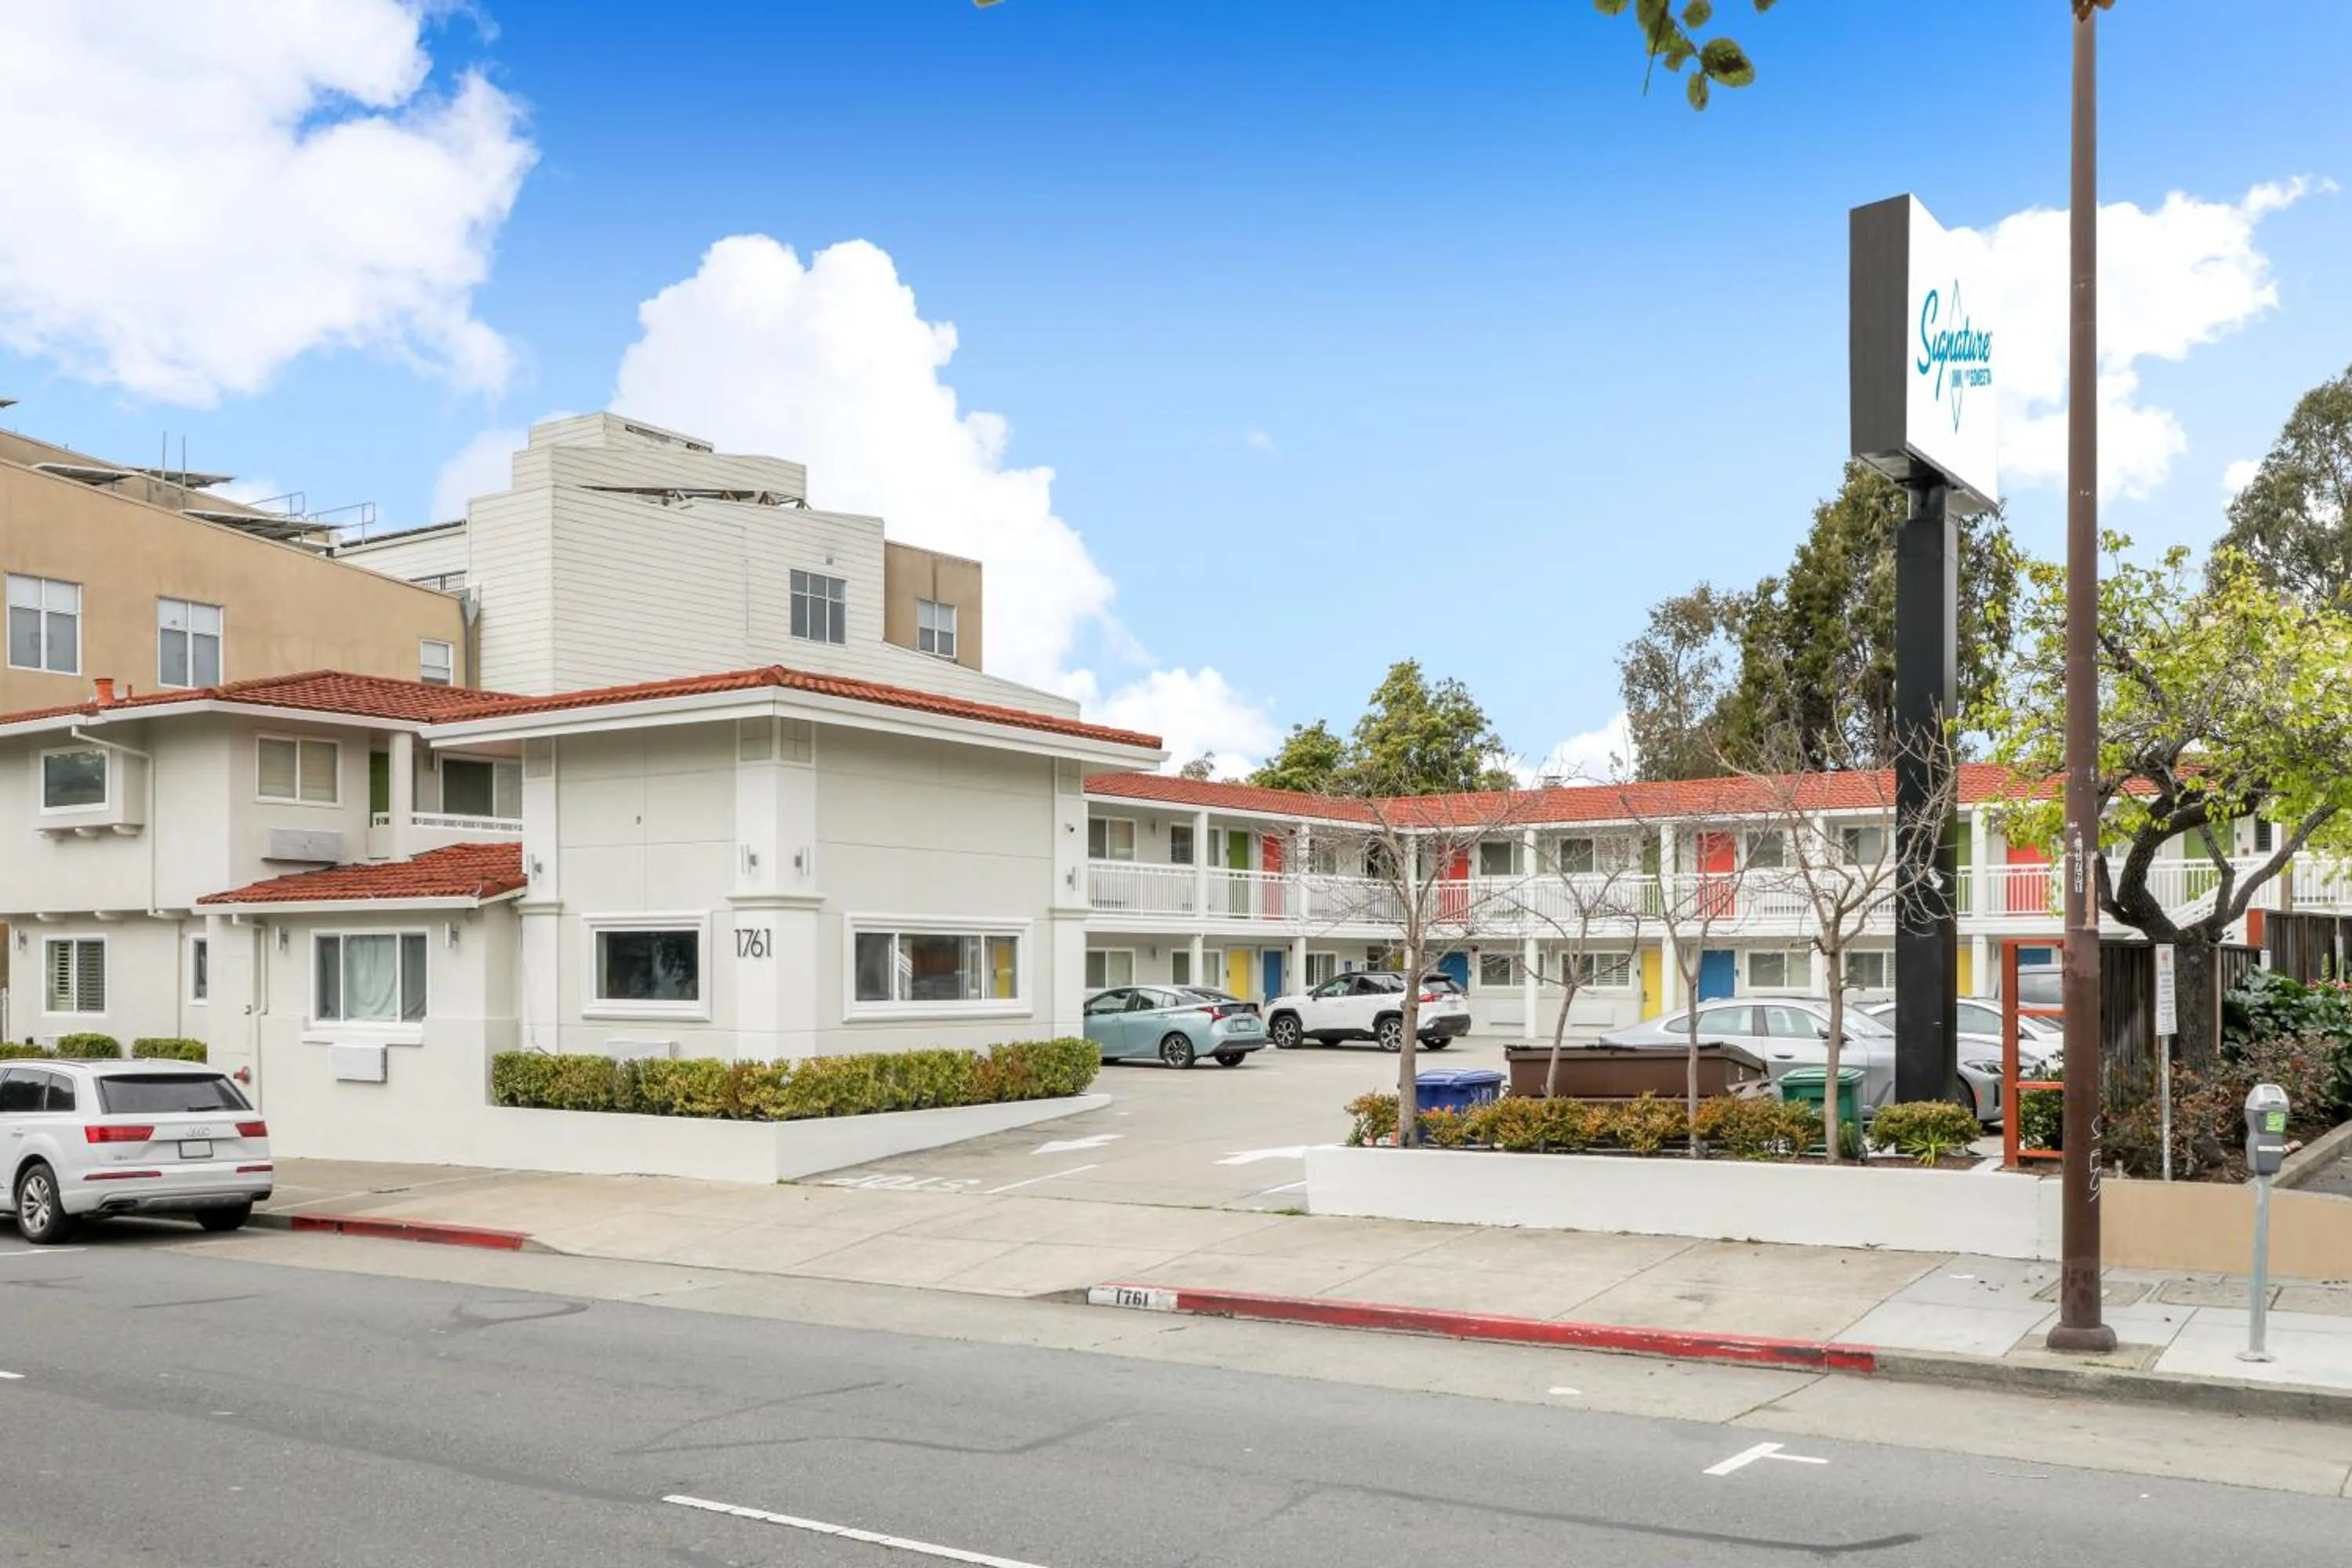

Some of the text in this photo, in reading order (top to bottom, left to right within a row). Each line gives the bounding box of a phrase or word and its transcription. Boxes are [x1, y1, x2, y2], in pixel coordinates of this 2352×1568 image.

[1917, 289, 1991, 402] Signature
[734, 928, 771, 957] 1761
[1115, 1287, 1149, 1308] 1761
